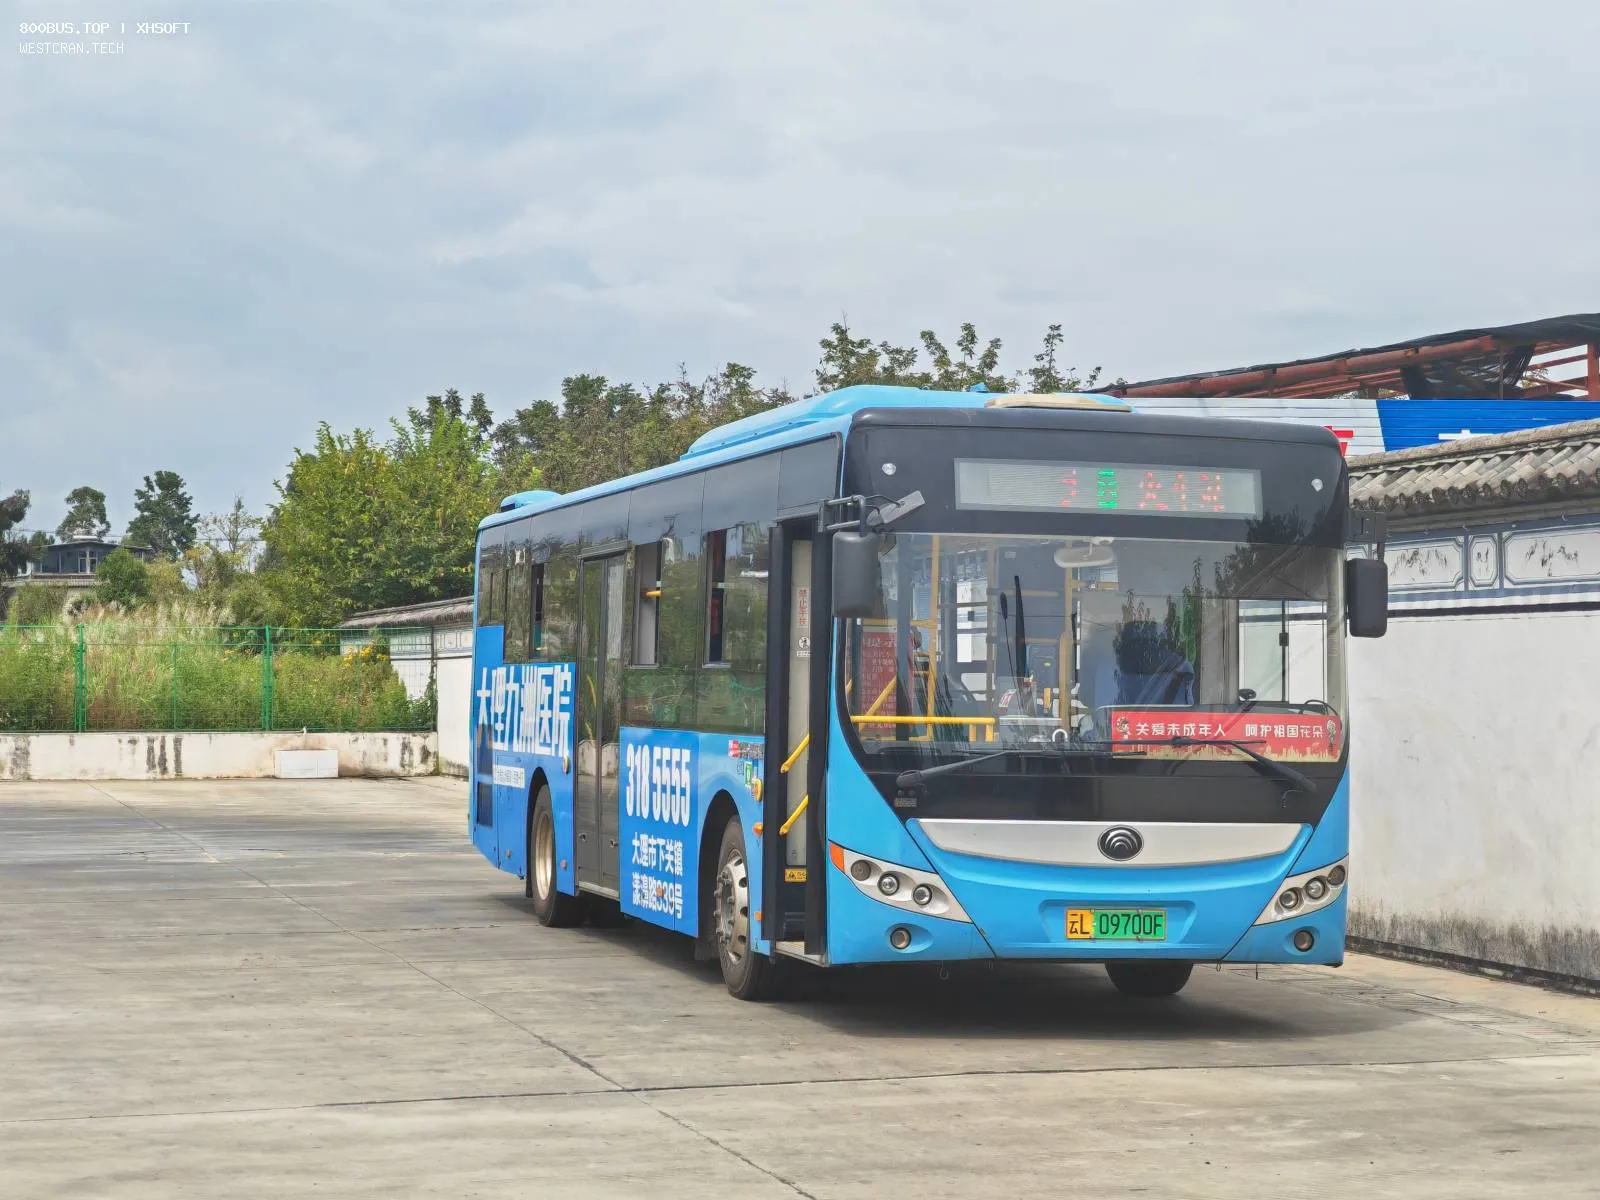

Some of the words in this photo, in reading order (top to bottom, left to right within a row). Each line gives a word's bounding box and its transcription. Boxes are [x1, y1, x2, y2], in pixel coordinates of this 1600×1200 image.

[1135, 722, 1226, 737] 关爱未成年人
[1245, 723, 1324, 739] 呵护祖国花朵
